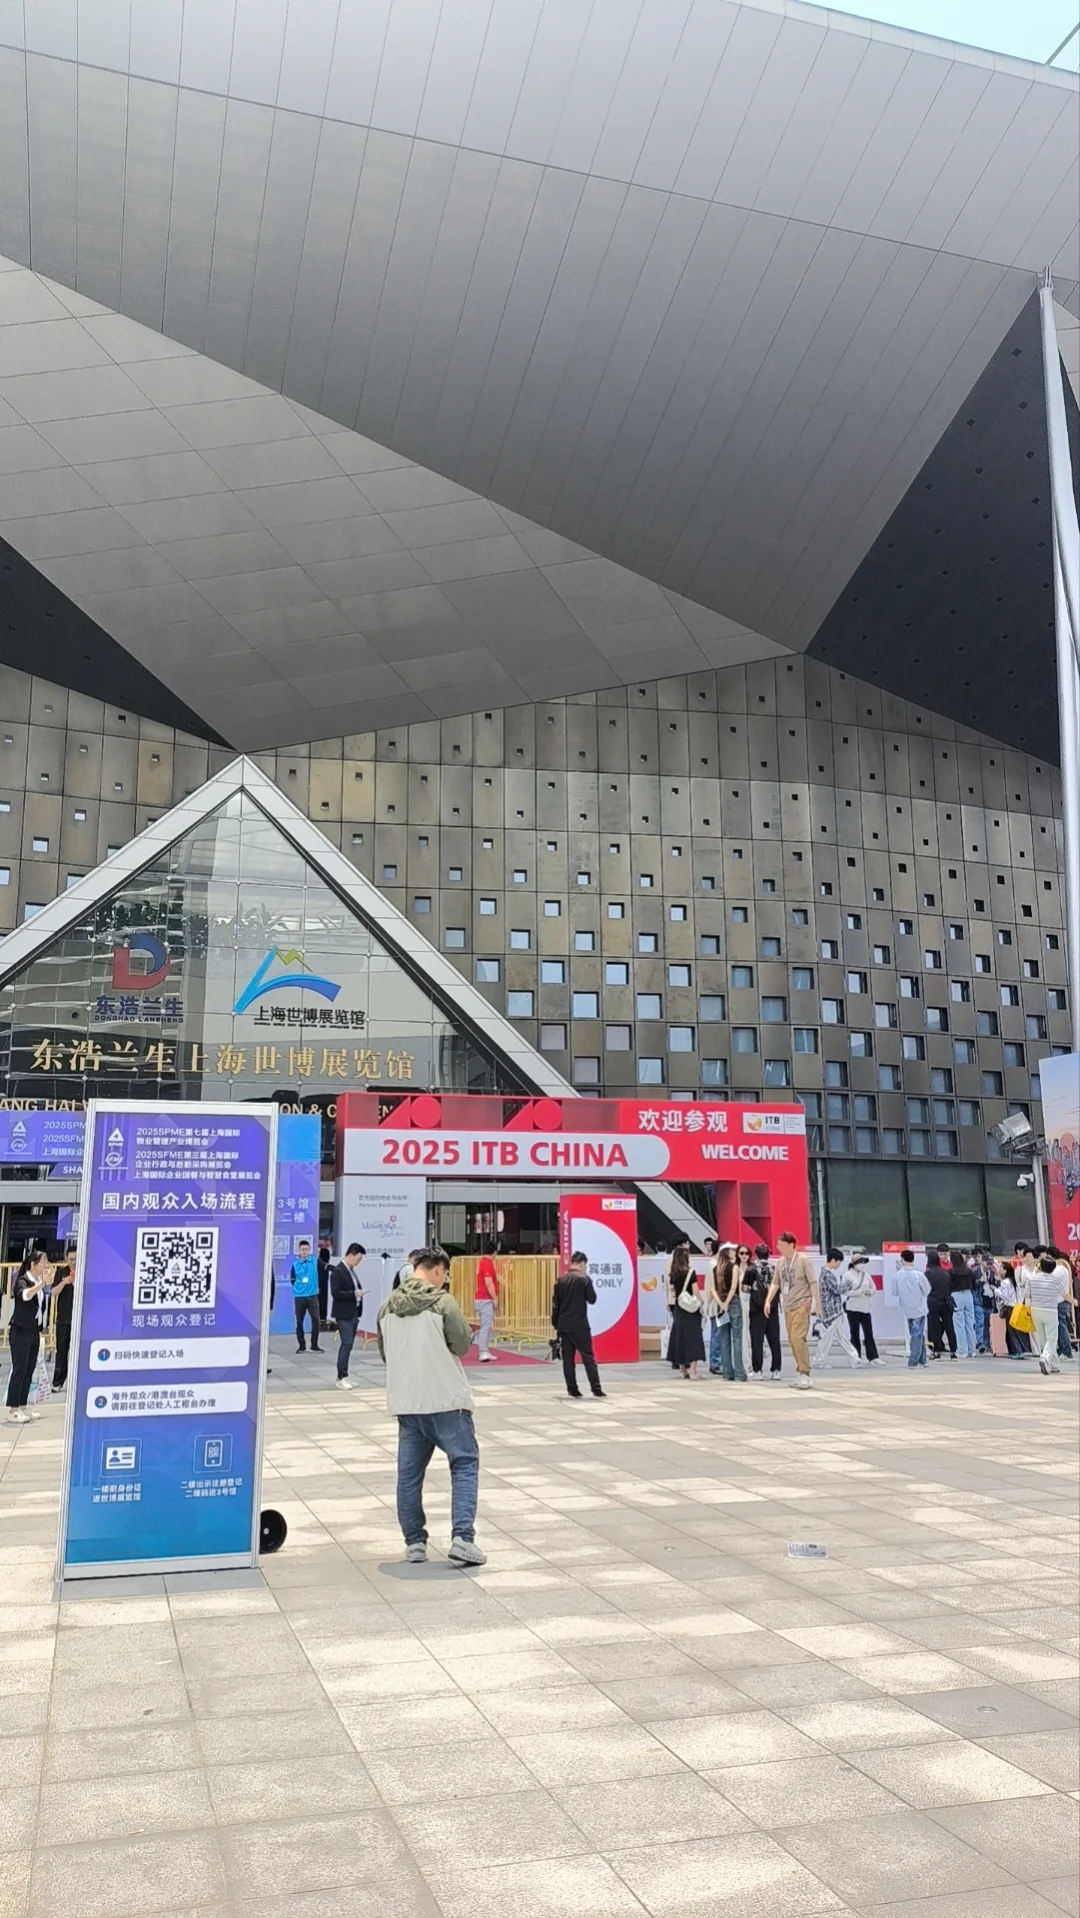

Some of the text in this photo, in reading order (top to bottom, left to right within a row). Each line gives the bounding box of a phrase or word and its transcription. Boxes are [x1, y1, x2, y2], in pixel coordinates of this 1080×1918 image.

[95, 995, 184, 1016] 东浩兰生
[254, 1006, 365, 1026] 上海世博展览馆
[30, 1038, 415, 1080] 东浩兰生上海世博展览馆
[638, 1109, 728, 1133] 欢迎参观
[765, 1116, 780, 1125] ITB
[136, 1127, 241, 1137] 2025SPME第七届上海国际
[136, 1137, 209, 1146] 物业管理产业博览会
[135, 1151, 239, 1160] 2025SFME第三届上海国际
[382, 1139, 629, 1168] 2025 ITB CHINA
[701, 1144, 789, 1161] WELCOME
[102, 1192, 256, 1210] 国内观众入场流程
[585, 1263, 623, 1276] 宾通道
[596, 1278, 624, 1288] ONLY
[131, 1313, 216, 1328] 现场观众登记
[114, 1349, 184, 1360] 扫码快速登记入场
[111, 1389, 195, 1401] 海外观众/港澳台观众
[111, 1398, 216, 1411] 请前往登记处人工柜台办理
